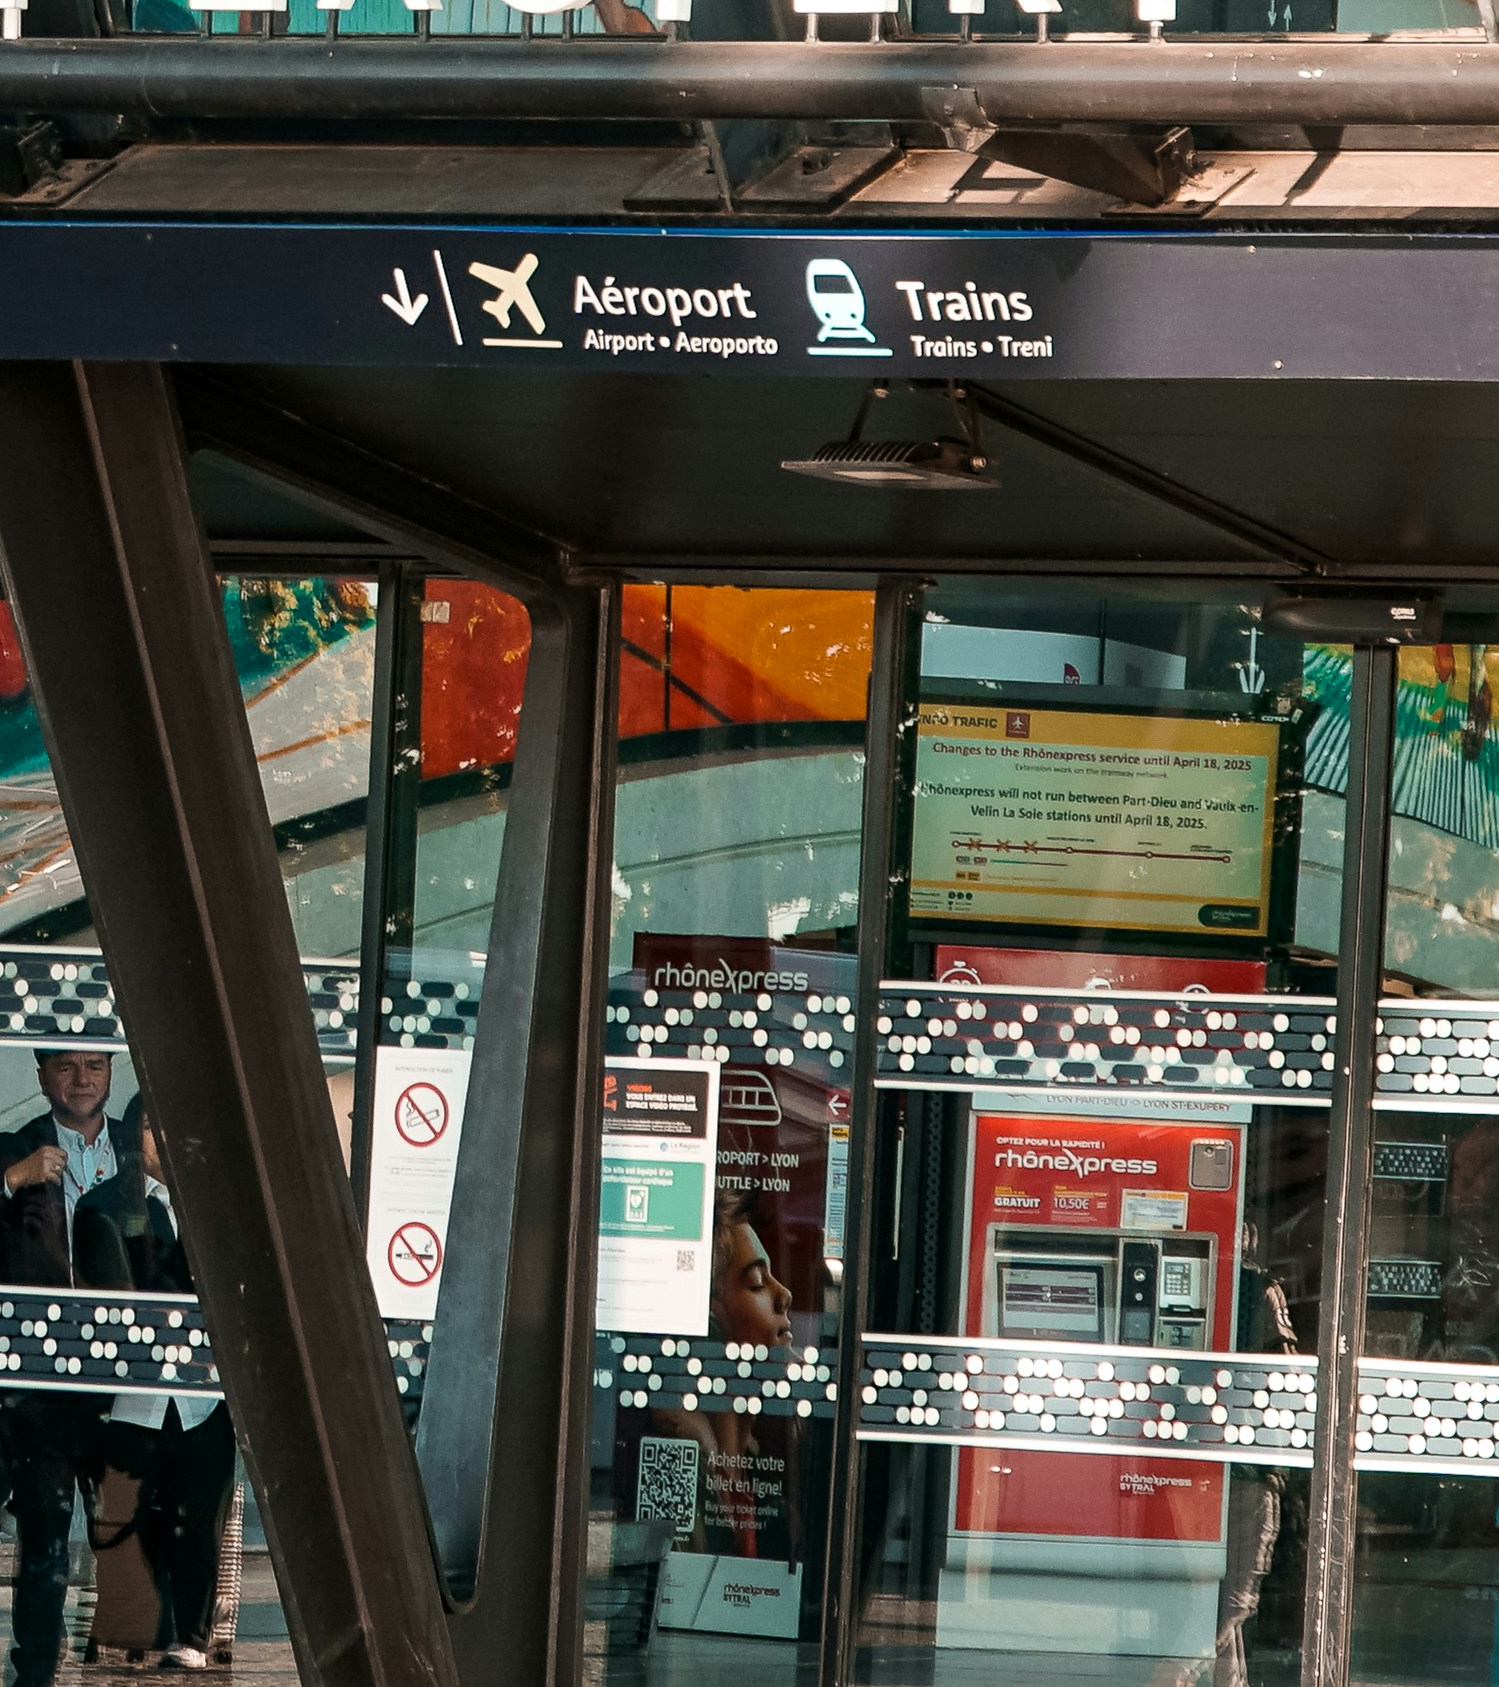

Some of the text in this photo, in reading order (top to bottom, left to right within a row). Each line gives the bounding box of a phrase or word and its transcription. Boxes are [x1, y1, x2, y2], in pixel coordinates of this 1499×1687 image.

[574, 276, 757, 326] Aéroport
[895, 280, 1033, 322] Trains
[584, 328, 778, 358] Airport Aeroporto
[910, 335, 1053, 358] Trains Treni
[952, 716, 998, 728] TRAFIC
[932, 742, 1252, 771] Changes to the Rhônexpress service until April 18, 2025
[999, 787, 1019, 799] will
[1022, 790, 1042, 801] not
[1045, 792, 1065, 802] run
[1068, 791, 1120, 805] between
[1123, 794, 1184, 809] Part-Dieu
[970, 805, 1000, 817] Velin
[1003, 807, 1015, 818] La
[1046, 809, 1092, 823] stations
[1095, 812, 1122, 824] until
[1124, 813, 1153, 828] April
[1156, 816, 1173, 828] 18,
[1176, 817, 1207, 830] 2025.
[654, 958, 809, 994] rhônexpress
[1143, 1099, 1169, 1109] LYON
[1025, 1138, 1048, 1147] POUR
[1050, 1138, 1062, 1147] LA
[771, 1153, 799, 1168] LYON
[994, 1148, 1158, 1179] rhônexpress
[763, 1178, 790, 1192] LYON
[994, 1197, 1041, 1208] GRATUIT
[707, 1451, 785, 1472] Achetez votre
[706, 1474, 783, 1498] billet en ligne!
